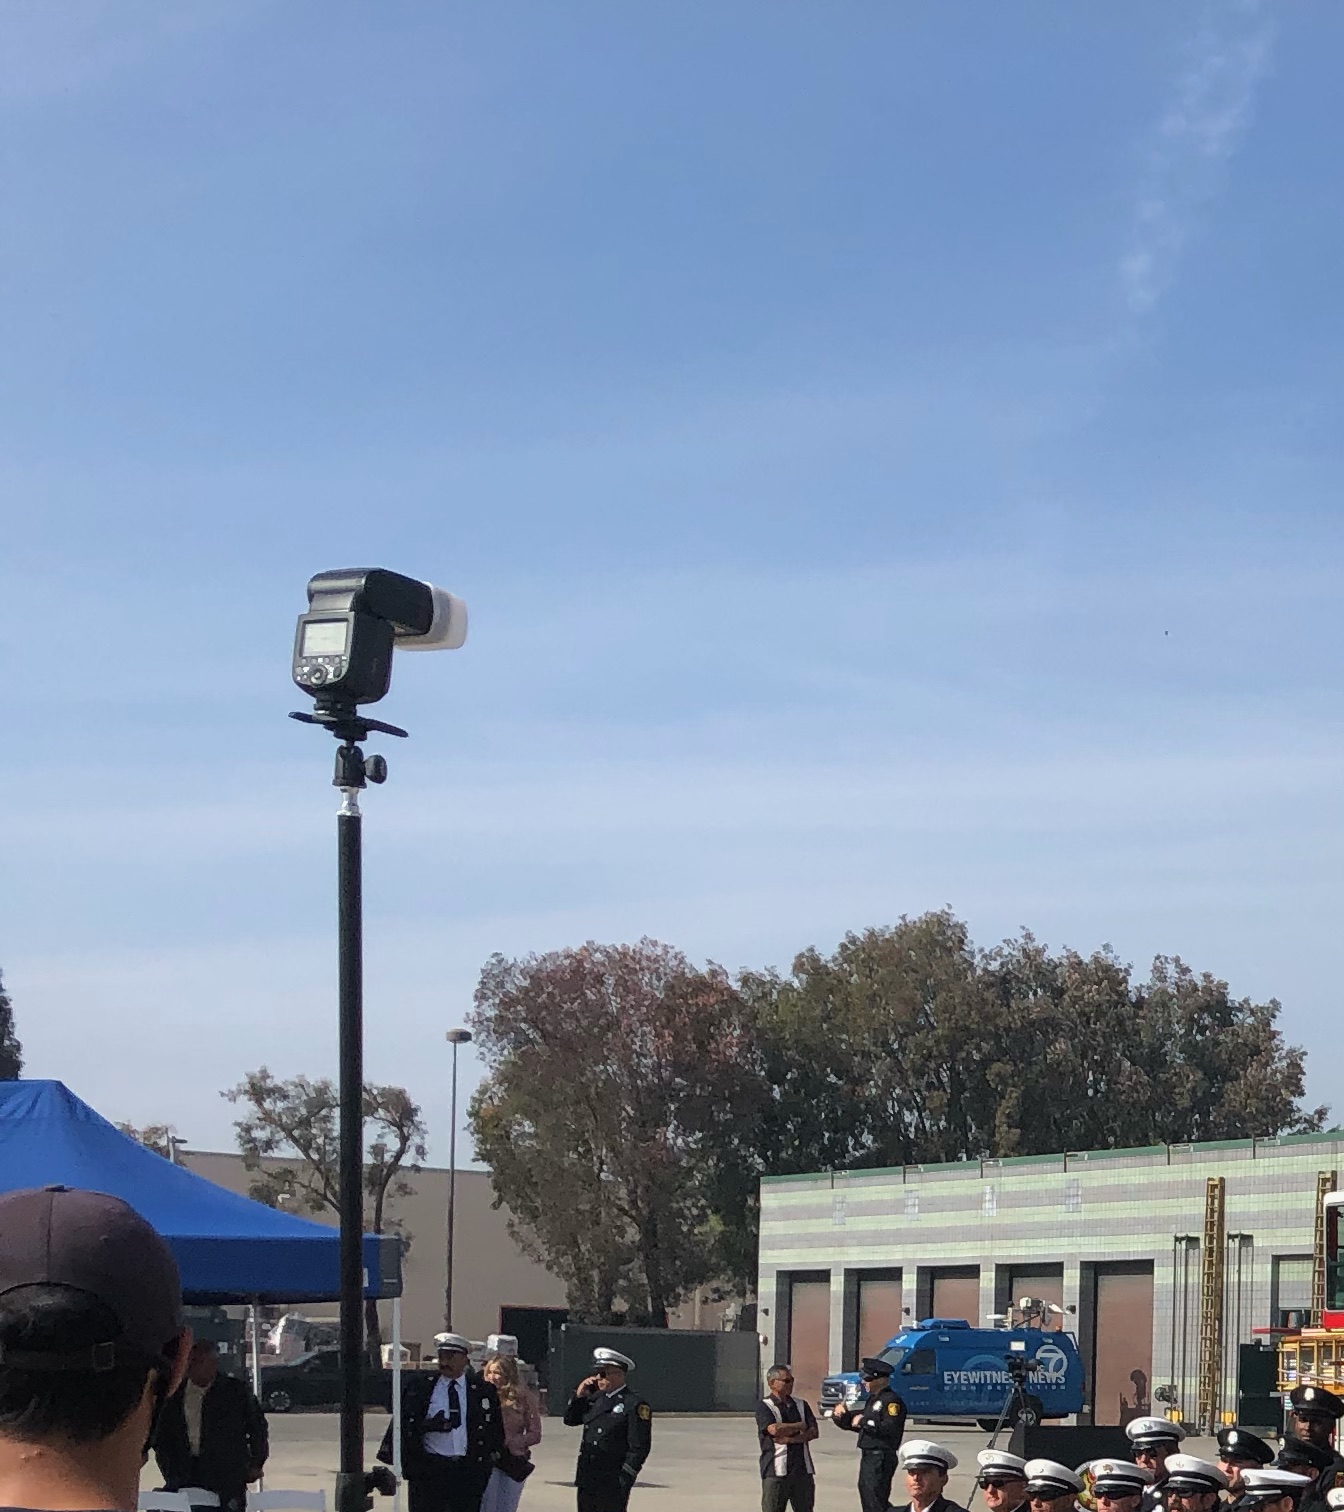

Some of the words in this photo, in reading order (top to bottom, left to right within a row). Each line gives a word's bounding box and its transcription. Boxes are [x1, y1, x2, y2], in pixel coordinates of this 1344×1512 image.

[1036, 1346, 1067, 1377] 7
[943, 1371, 1014, 1384] EYEWITNE
[1029, 1371, 1066, 1384] NEWS
